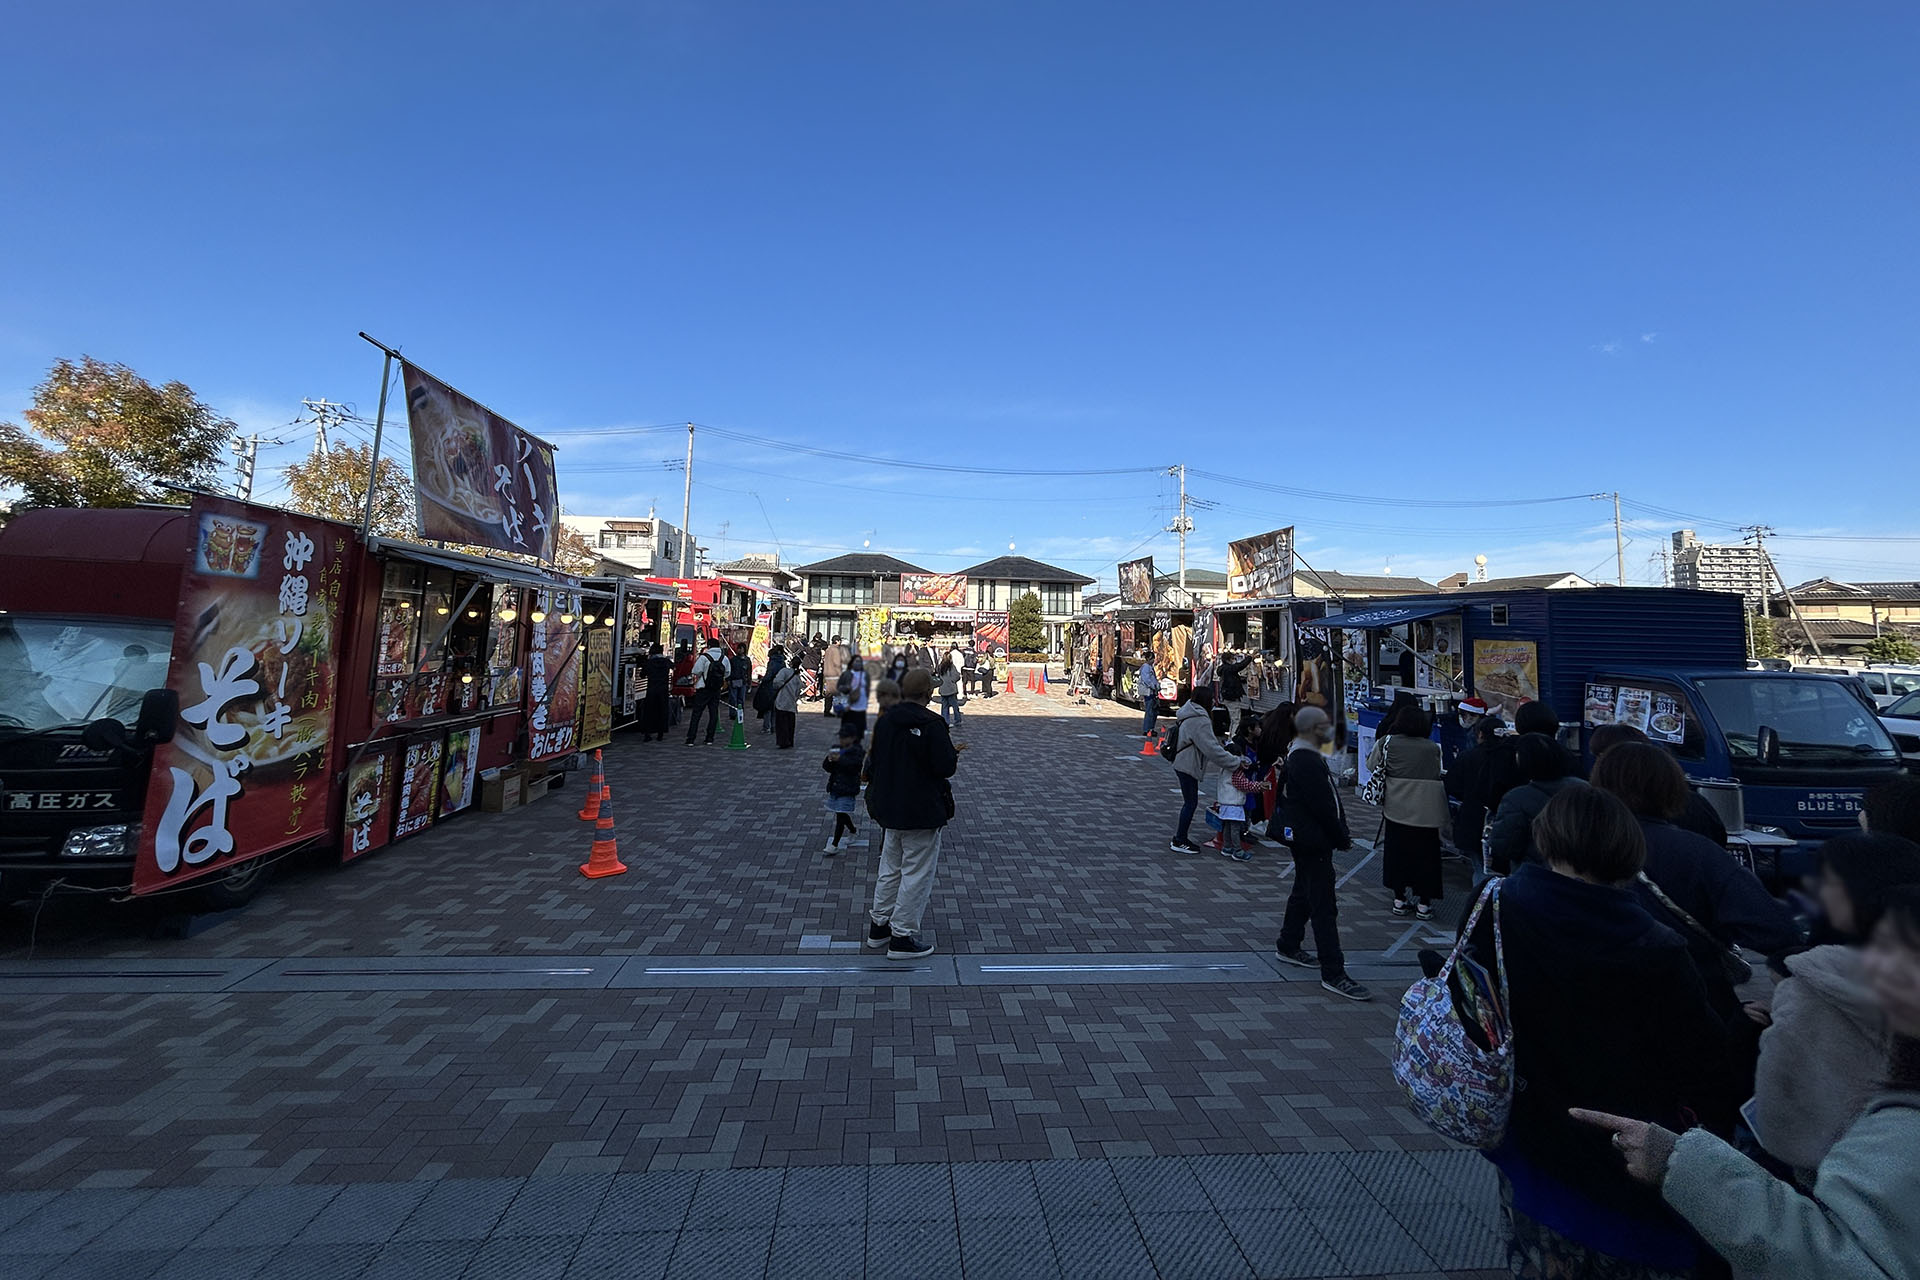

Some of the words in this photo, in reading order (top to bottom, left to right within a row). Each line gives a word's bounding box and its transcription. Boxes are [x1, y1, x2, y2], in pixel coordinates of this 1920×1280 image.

[493, 463, 529, 549] そば
[262, 530, 315, 740] 沖縄ソーキ
[376, 663, 404, 675] おにぎり
[422, 674, 441, 716] そば
[460, 683, 471, 709] そば
[154, 646, 261, 875] そば
[530, 726, 574, 761] おにぎり
[9, 792, 117, 810] 高圧ガス
[1844, 800, 1865, 811] BL
[351, 791, 373, 854] そば
[394, 813, 430, 837] おにぎり
